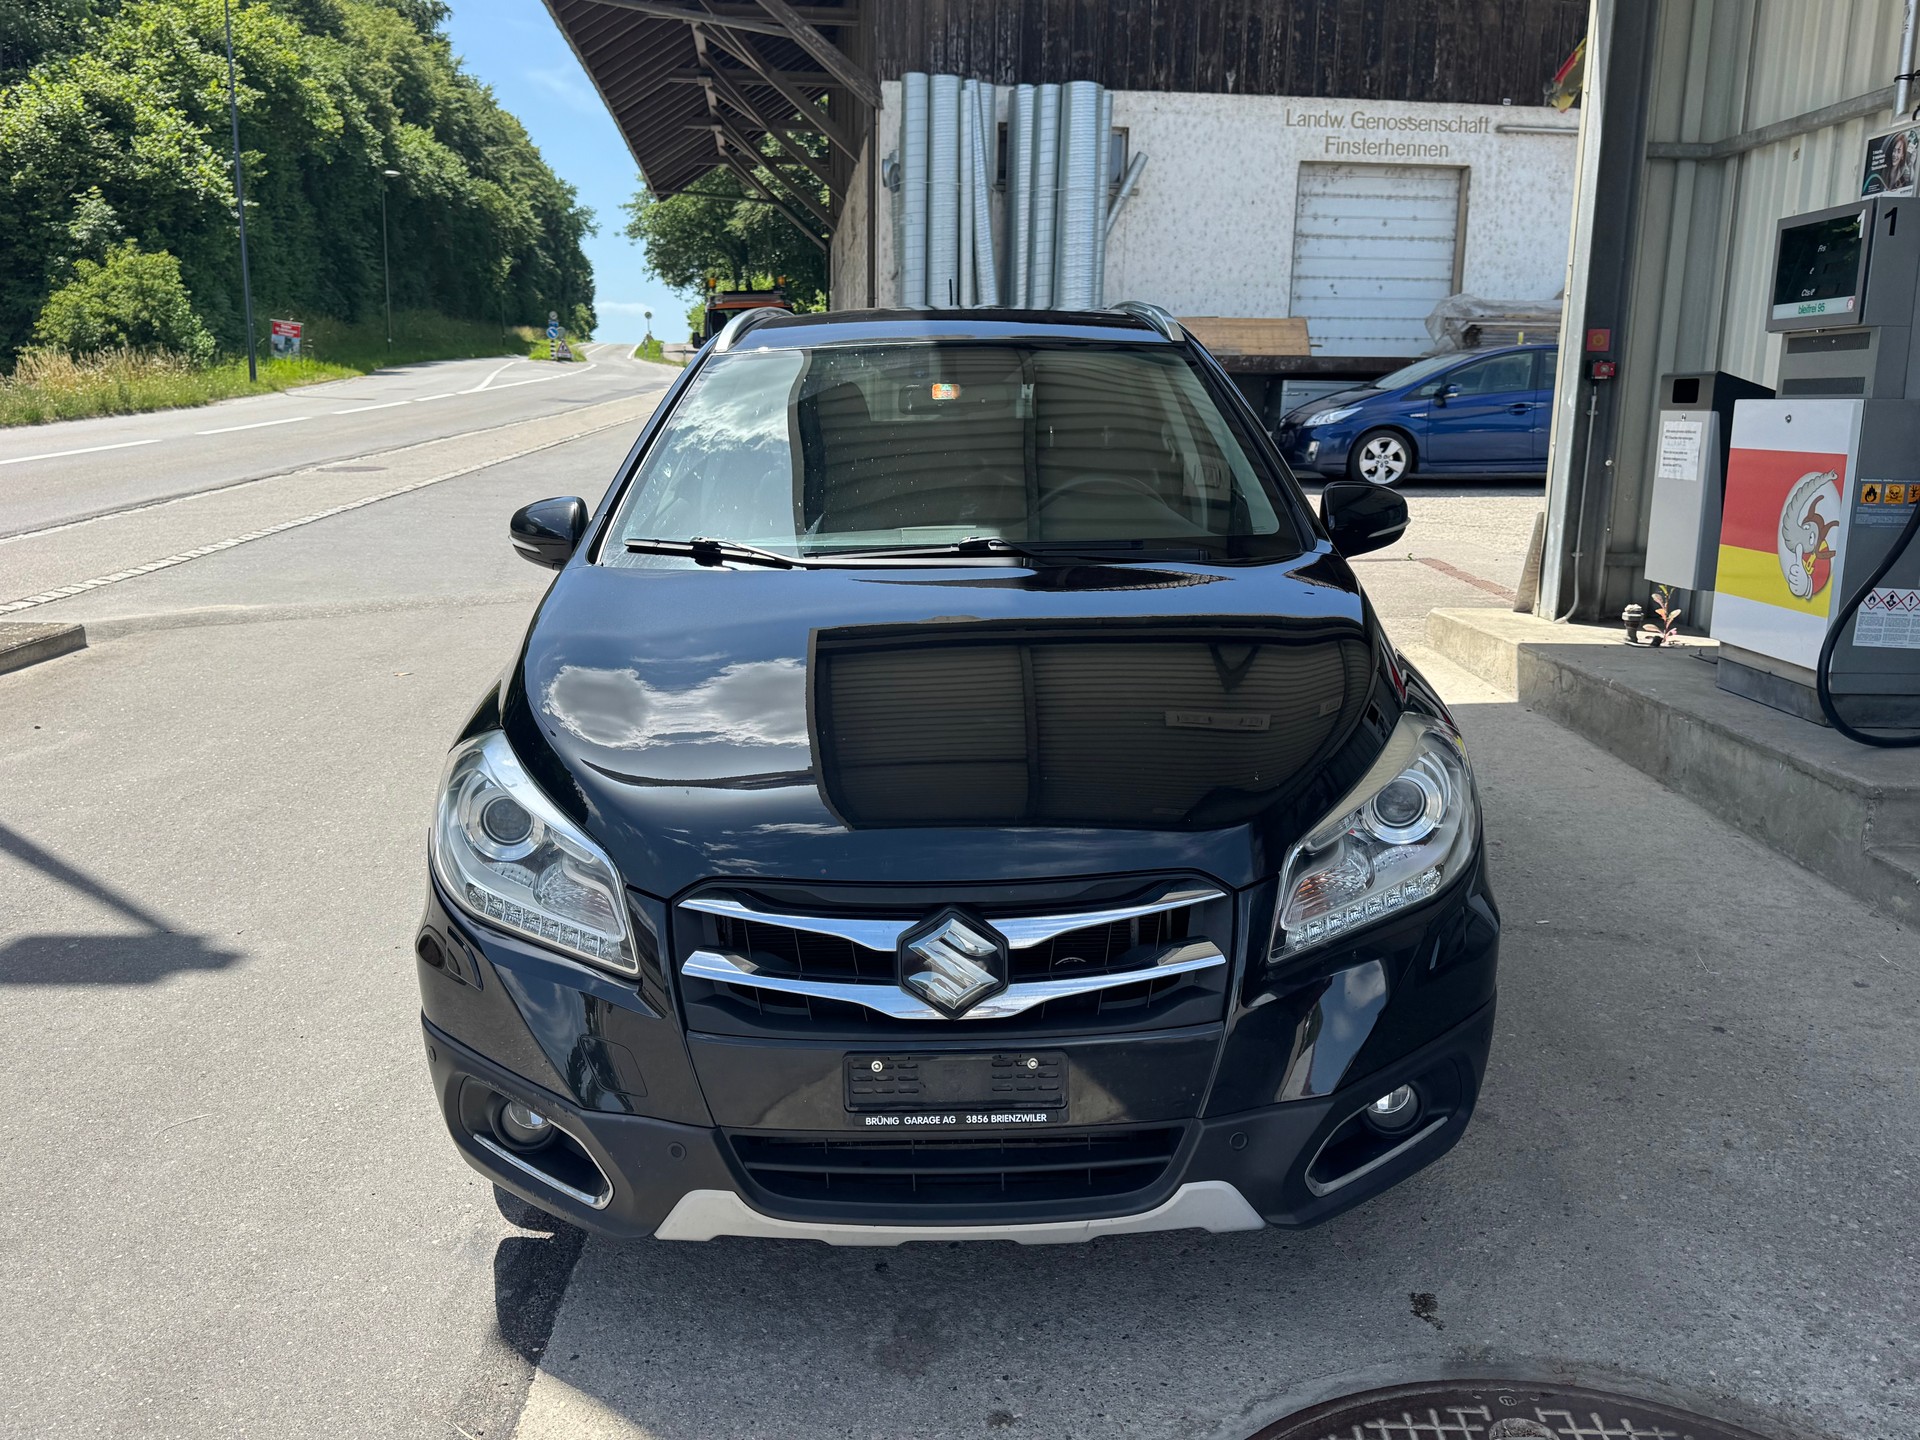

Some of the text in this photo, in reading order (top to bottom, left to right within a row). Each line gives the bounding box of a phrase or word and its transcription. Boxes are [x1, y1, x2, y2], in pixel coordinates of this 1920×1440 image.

[1286, 109, 1490, 134] Landw. Genossenschaft
[1325, 136, 1449, 158] Finsterhennen
[1857, 209, 1866, 238] 1
[1884, 207, 1898, 236] 1
[865, 1114, 1047, 1126] BRÜNIG GARAGE AG 3856 BRIENZWILER
